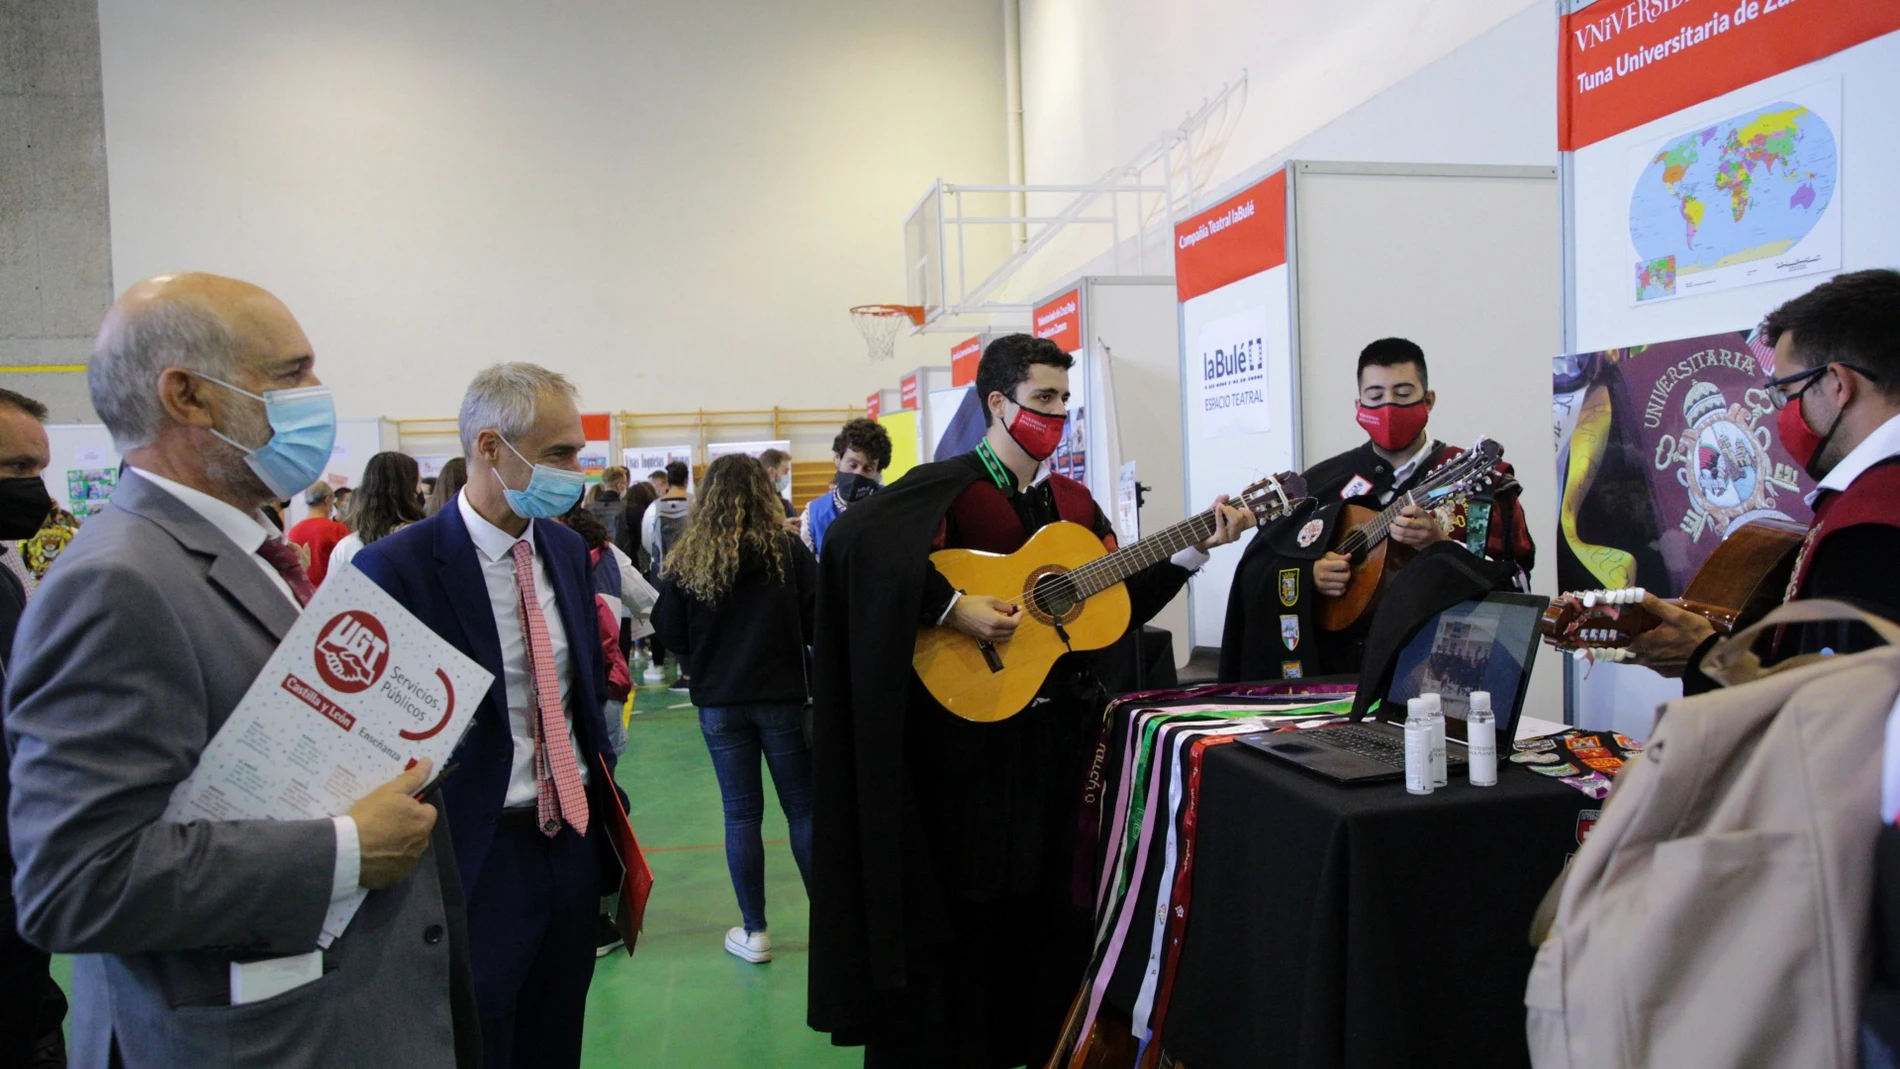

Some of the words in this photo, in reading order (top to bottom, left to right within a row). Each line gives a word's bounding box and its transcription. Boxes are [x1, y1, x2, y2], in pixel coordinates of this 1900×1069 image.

[1577, 67, 1613, 94] Tuna
[1616, 12, 1730, 78] Universitaria
[1734, 0, 1759, 27] de
[1179, 220, 1210, 249] Compañía
[1208, 211, 1232, 234] Teatral
[1231, 199, 1255, 226] laBulé
[1203, 343, 1247, 381] laBulé
[1205, 394, 1231, 411] ESPACIO
[1232, 389, 1264, 407] TEATRAL
[1644, 348, 1755, 429] UNIVERSITARIA
[335, 614, 388, 669] UGT
[285, 676, 323, 709] Castilla
[320, 702, 331, 716] y
[328, 704, 353, 728] León
[379, 680, 427, 722] Públicos
[358, 726, 402, 763] Enseñanza
